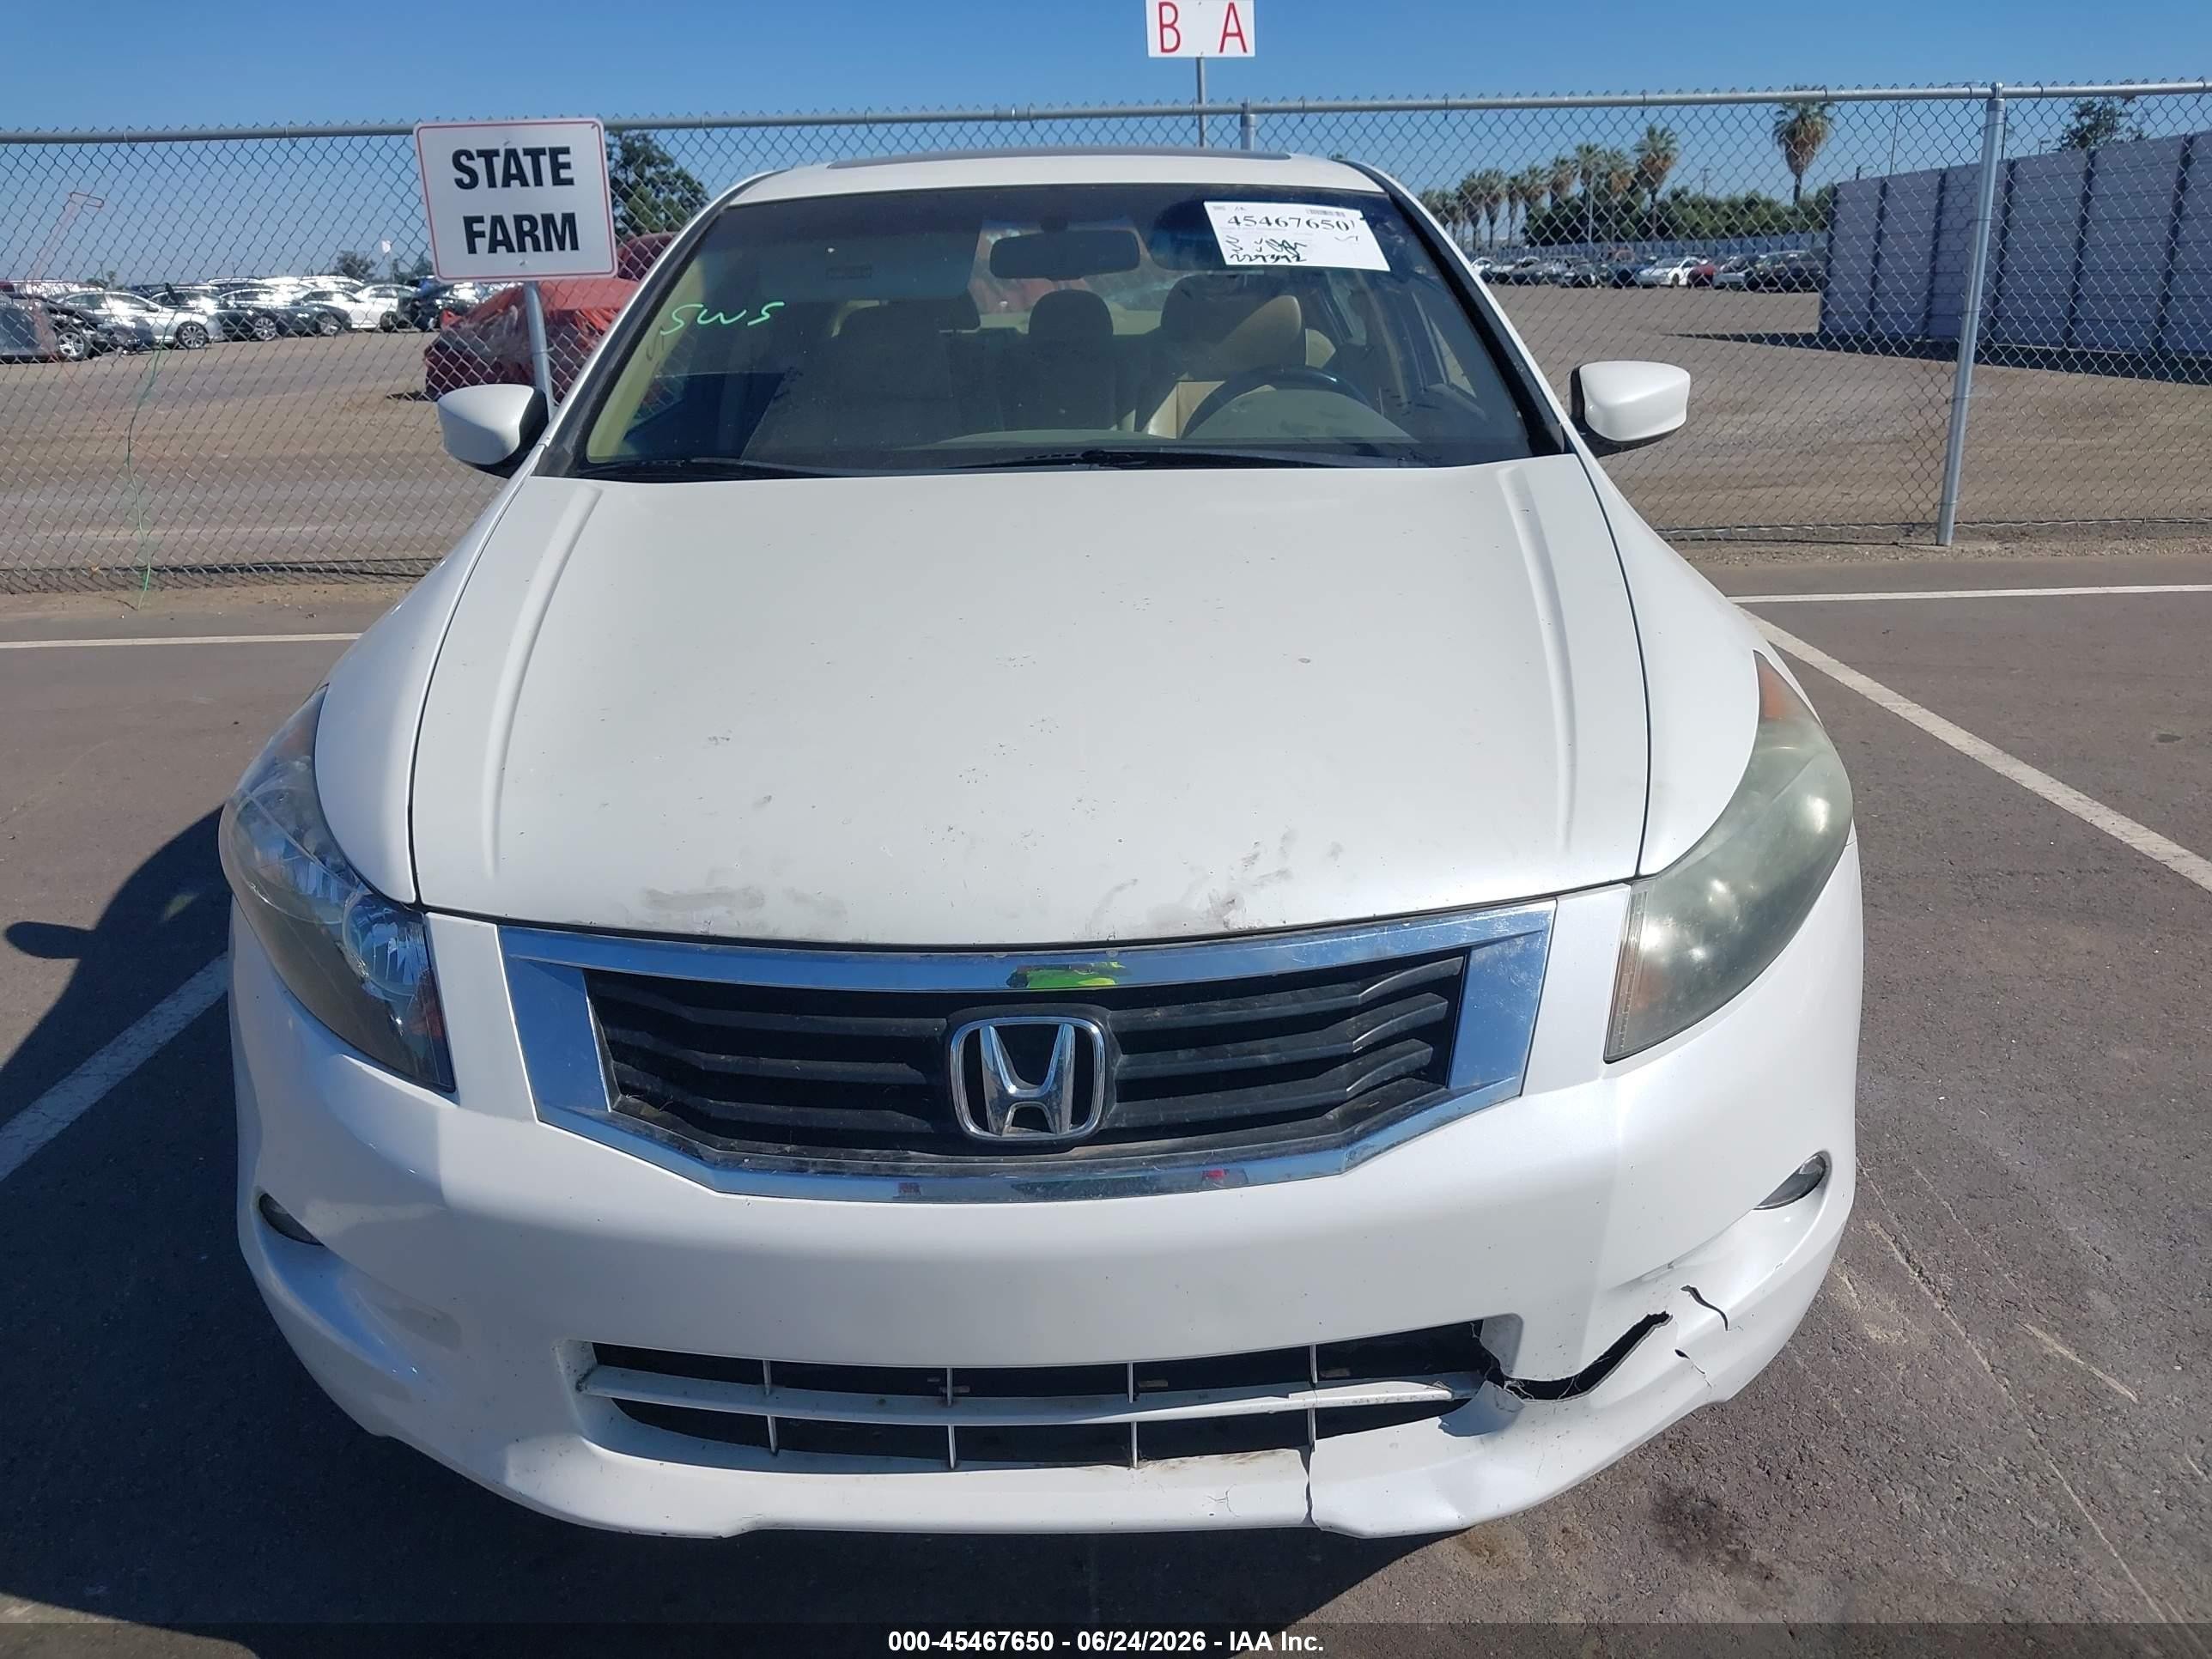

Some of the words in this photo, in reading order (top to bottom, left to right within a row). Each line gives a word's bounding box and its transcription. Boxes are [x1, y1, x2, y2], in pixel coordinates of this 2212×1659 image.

[1158, 2, 1181, 53] B
[1218, 2, 1248, 53] A
[452, 146, 574, 190] STATE
[463, 212, 580, 254] FARM
[1227, 215, 1350, 232] 45467650
